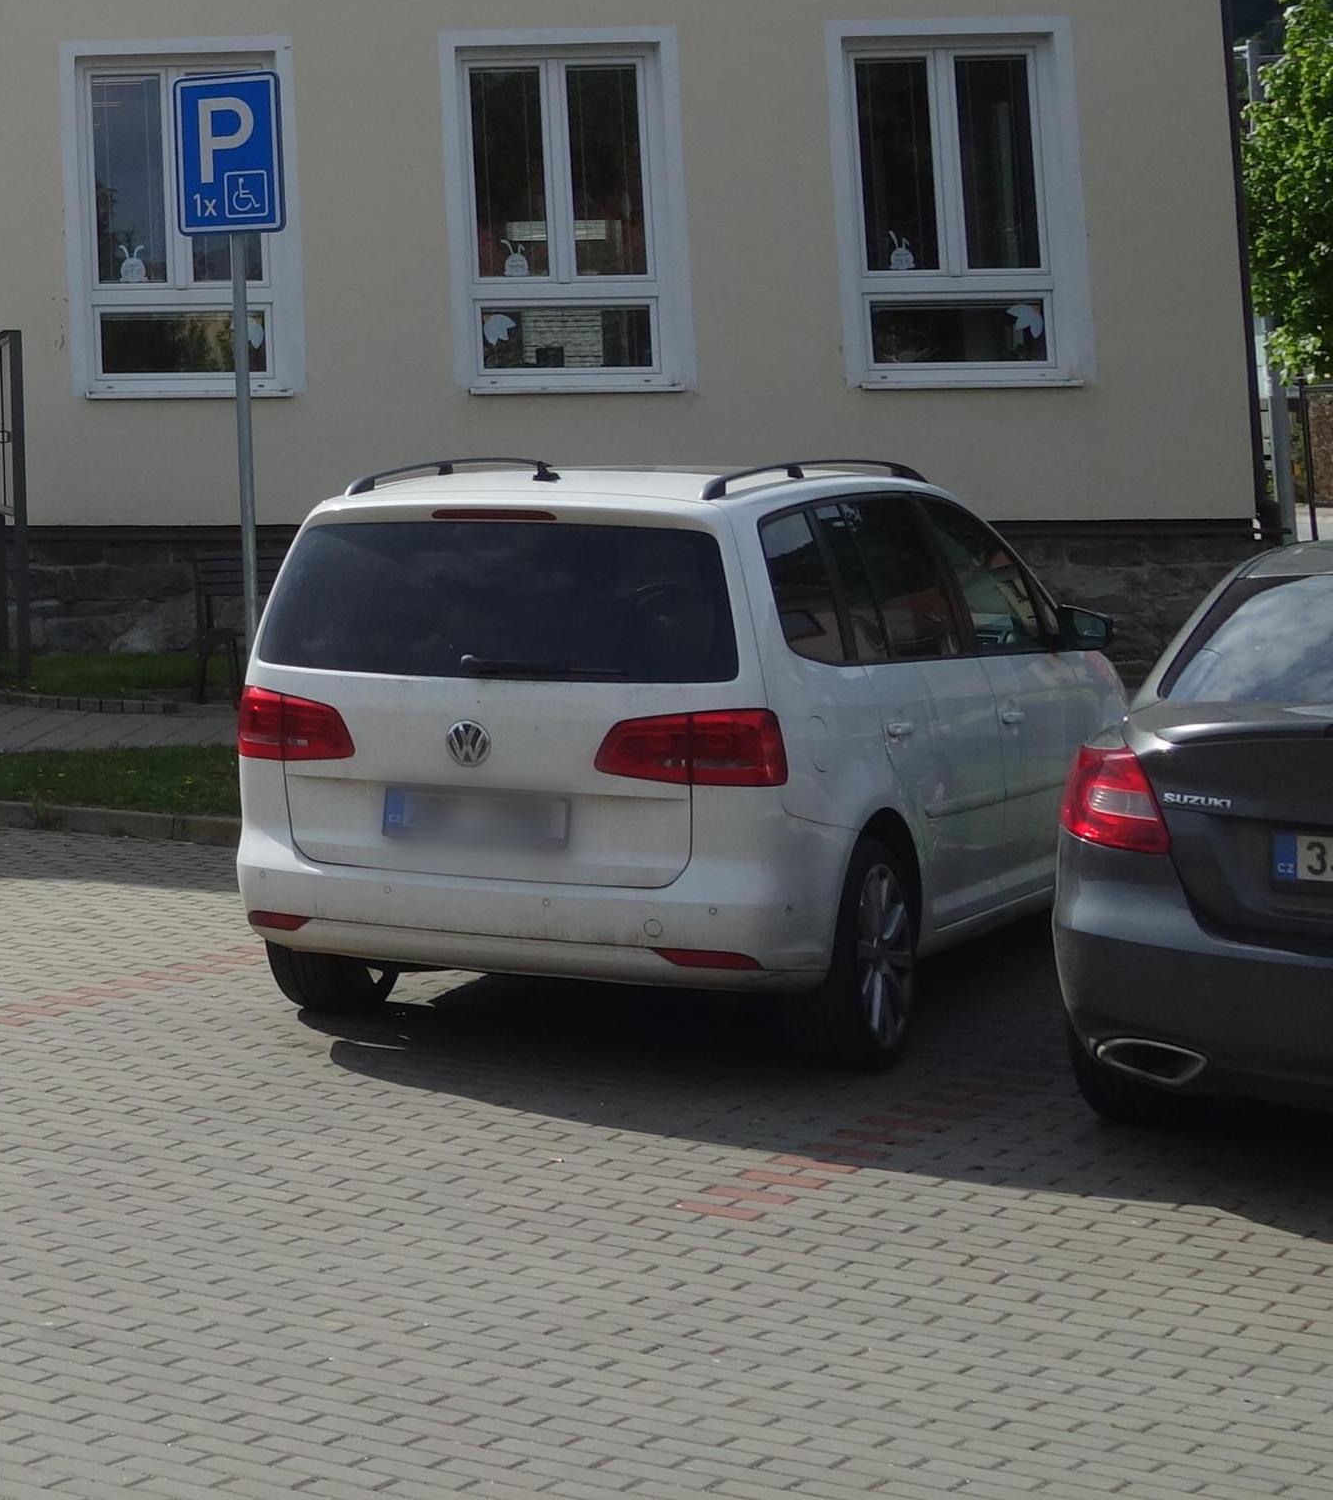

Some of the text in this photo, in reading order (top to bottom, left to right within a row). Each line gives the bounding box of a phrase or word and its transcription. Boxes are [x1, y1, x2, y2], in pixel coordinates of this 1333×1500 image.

[198, 97, 254, 183] P
[193, 193, 217, 217] 1x
[1163, 792, 1232, 809] SUZUKI
[1277, 862, 1295, 874] CZ
[1306, 841, 1333, 876] 3
